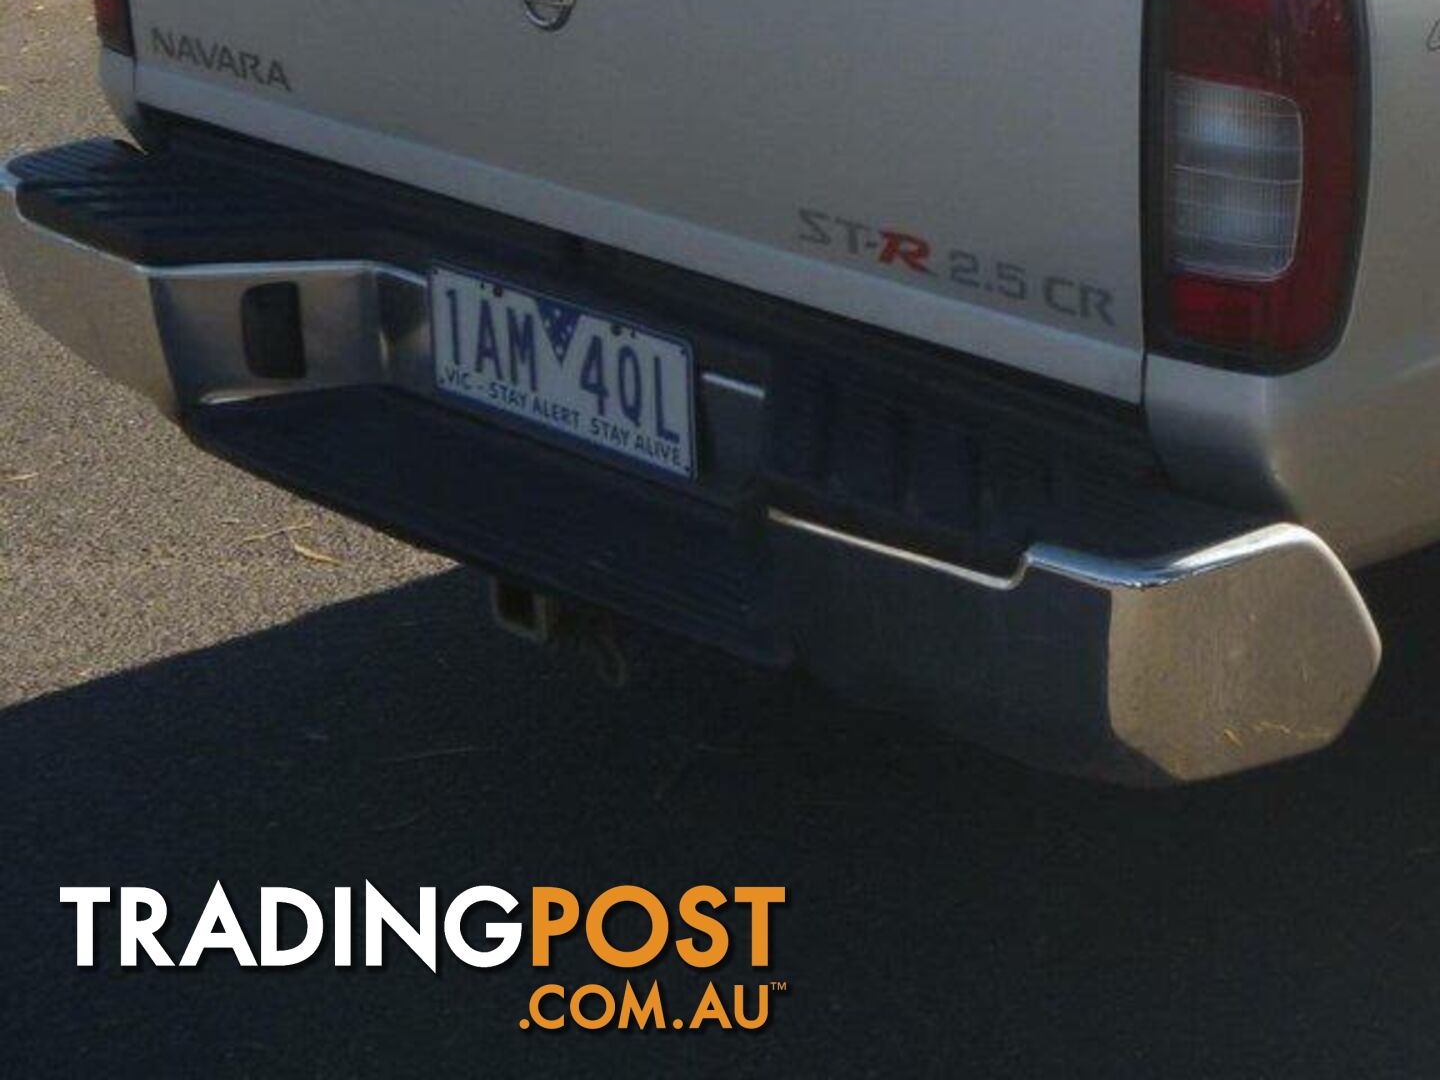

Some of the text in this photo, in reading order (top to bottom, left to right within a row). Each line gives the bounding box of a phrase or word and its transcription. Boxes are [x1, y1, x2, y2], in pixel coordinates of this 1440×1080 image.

[151, 26, 292, 93] NAVARA
[799, 207, 1116, 327] ST-R 2.5 CR
[446, 288, 538, 393] 1AM
[445, 367, 472, 392] VIC
[488, 383, 528, 409] STAY
[532, 397, 580, 430] ALERT
[590, 417, 630, 446] STAY
[634, 436, 682, 467] ALIVE
